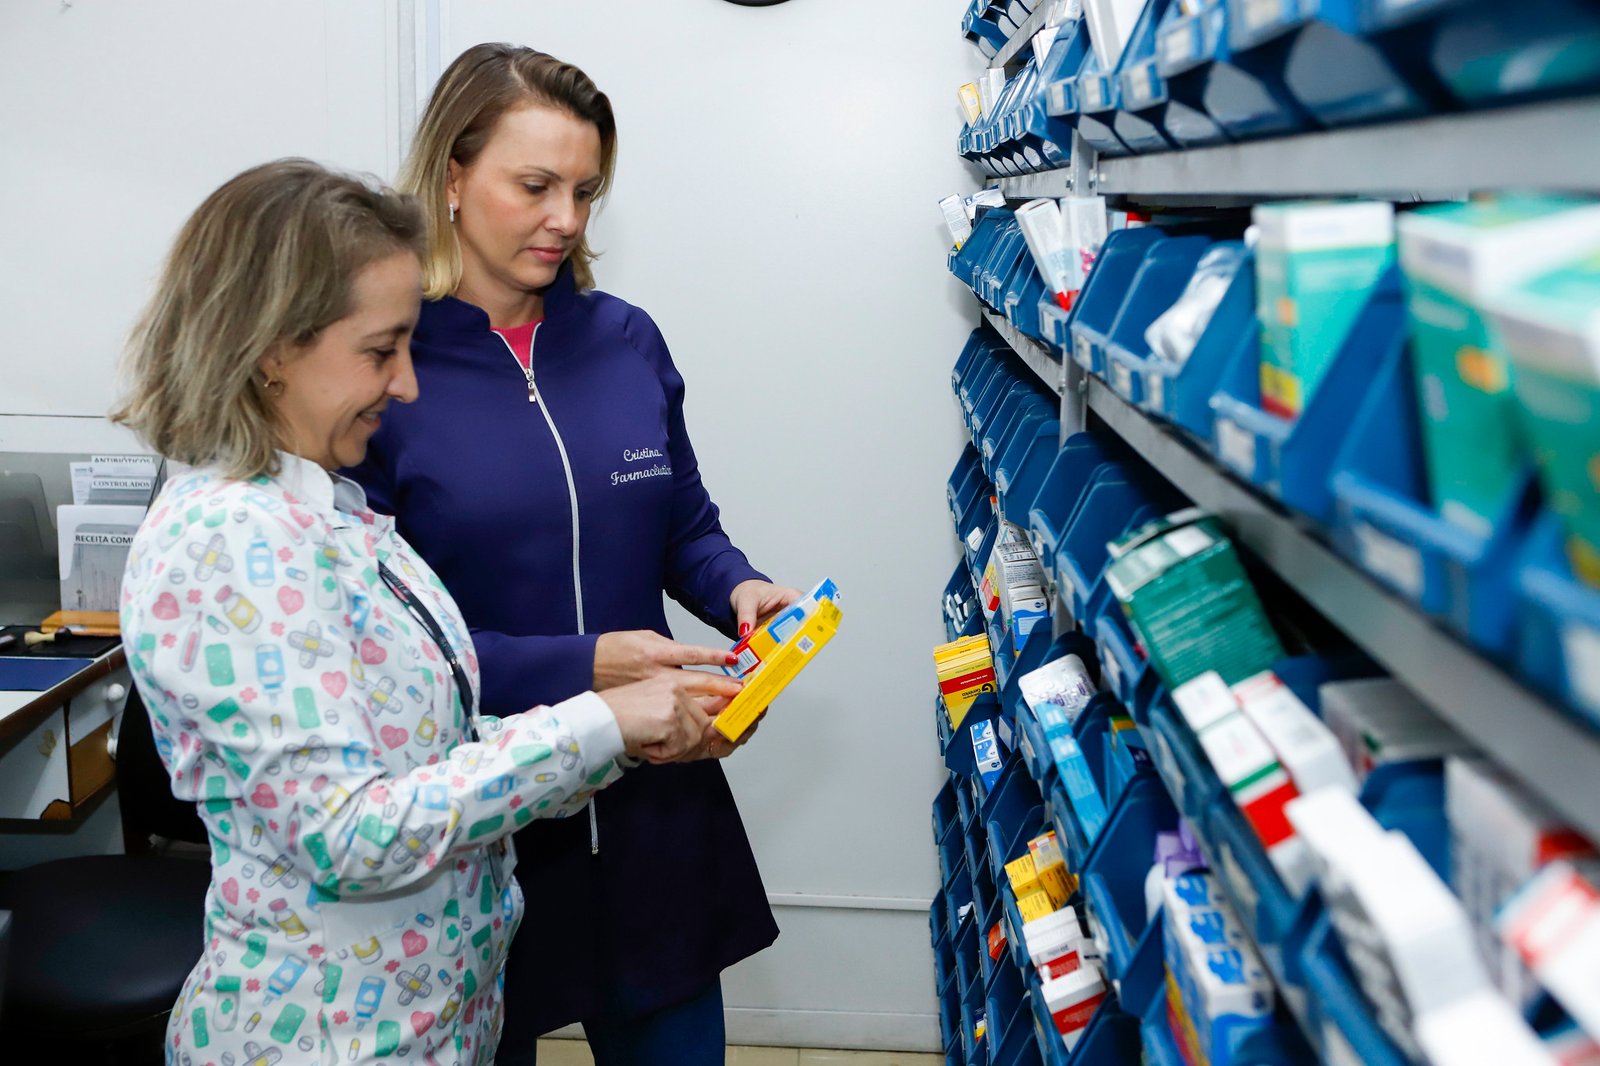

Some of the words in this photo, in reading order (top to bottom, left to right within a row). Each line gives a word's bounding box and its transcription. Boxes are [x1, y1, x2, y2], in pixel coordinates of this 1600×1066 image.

[623, 447, 663, 461] Cristina
[93, 480, 150, 488] CONTROLADOS
[75, 534, 109, 544] RECEITA
